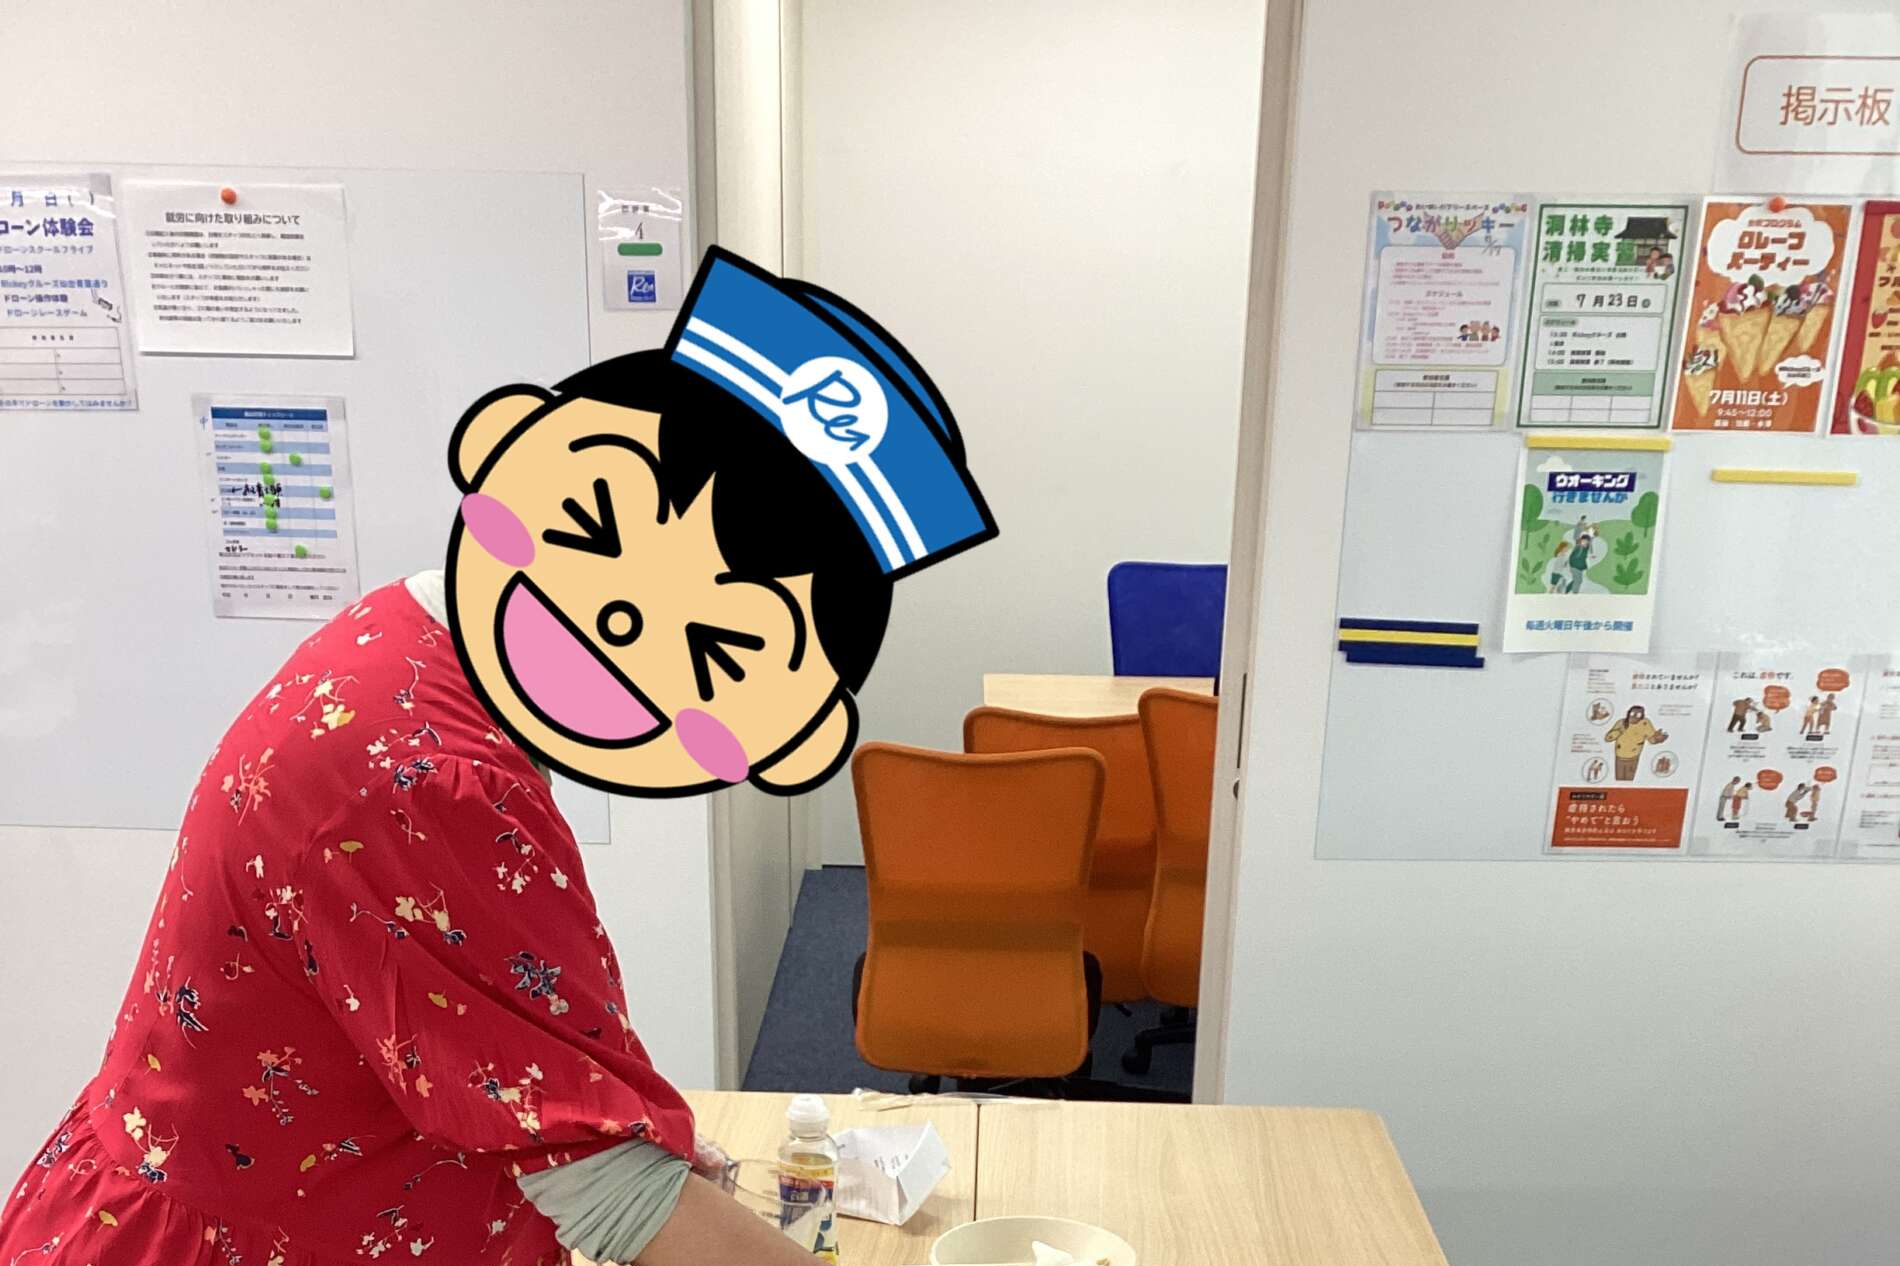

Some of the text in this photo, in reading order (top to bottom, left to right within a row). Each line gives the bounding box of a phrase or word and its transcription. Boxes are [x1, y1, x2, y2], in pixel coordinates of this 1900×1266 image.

[1780, 84, 1895, 126] 掲示板
[165, 211, 301, 225] 就労に向けた取り組みについて
[1545, 214, 1613, 236] 洞林寺
[1542, 240, 1635, 264] 清掃実習
[1726, 252, 1810, 271] パーティー
[1708, 390, 1788, 406] 7月11日(土)
[1552, 491, 1628, 504] 行きませんか
[1526, 619, 1633, 632] 毎週火曜日午後から開催
